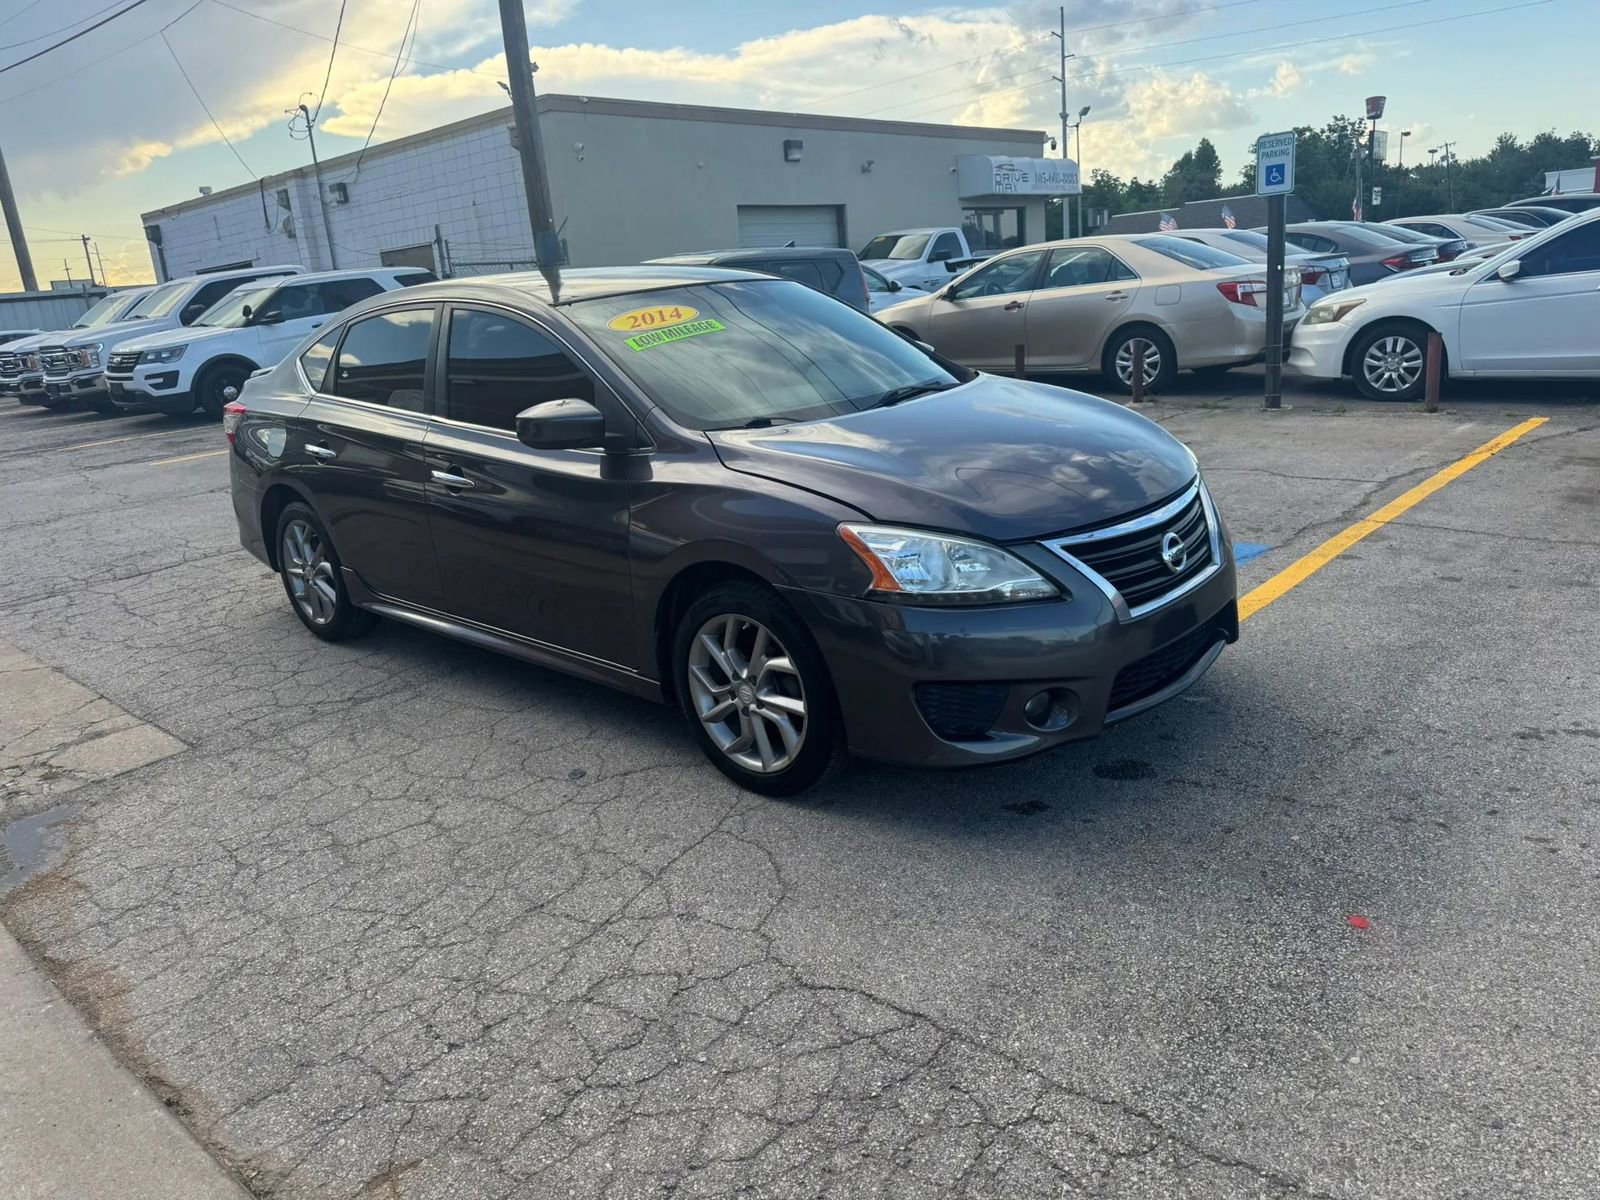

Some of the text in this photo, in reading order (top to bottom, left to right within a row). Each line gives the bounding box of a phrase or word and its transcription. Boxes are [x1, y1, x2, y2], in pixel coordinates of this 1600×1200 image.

[1260, 138, 1292, 149] RESERVED
[1261, 148, 1290, 160] PARKING
[995, 173, 1029, 183] DRIVE
[626, 307, 682, 329] 2014
[632, 320, 716, 347] LOW MILEAGE
